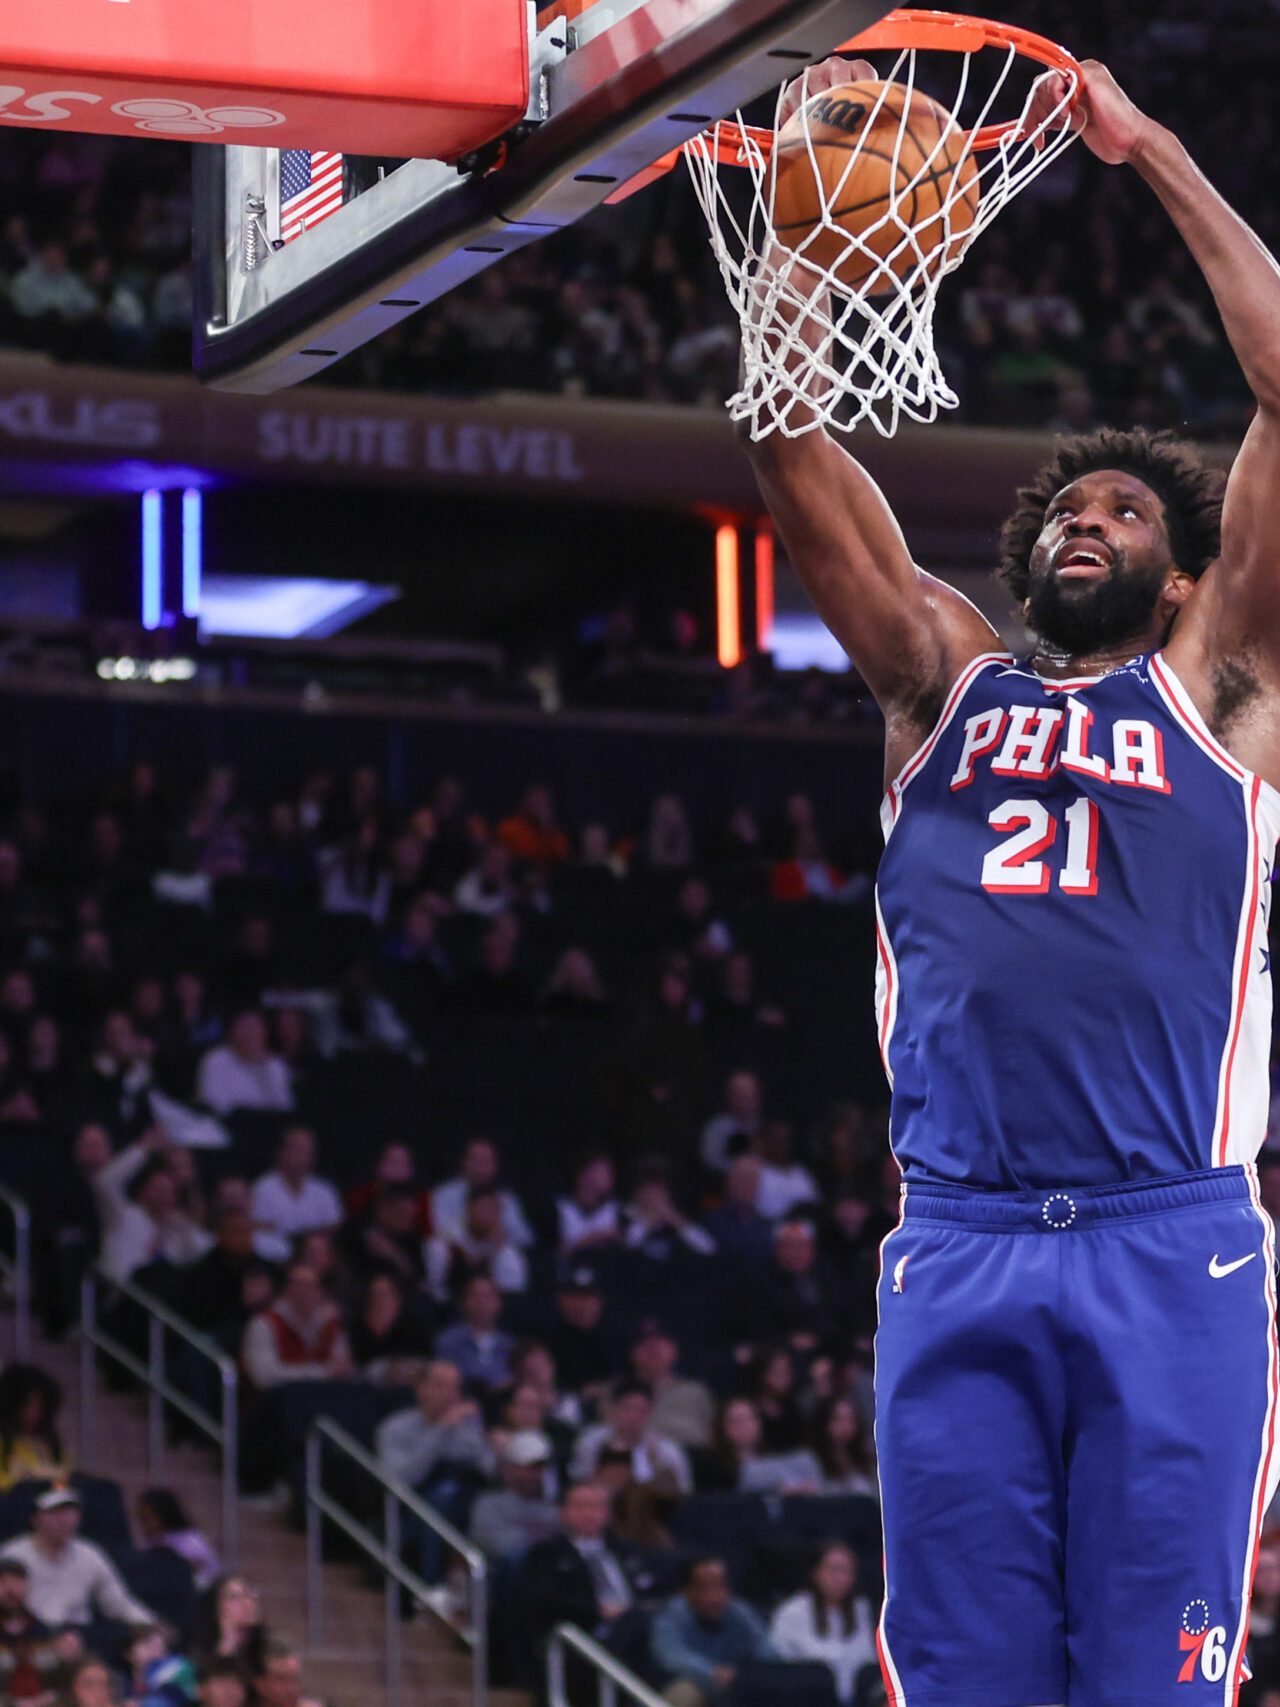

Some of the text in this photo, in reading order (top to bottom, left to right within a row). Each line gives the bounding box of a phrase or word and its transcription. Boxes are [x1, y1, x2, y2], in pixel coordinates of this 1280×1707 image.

[258, 411, 584, 482] SUITE LEVEL
[950, 695, 1172, 796] PHLA
[980, 797, 1100, 896] 21
[1177, 1625, 1227, 1683] 76
